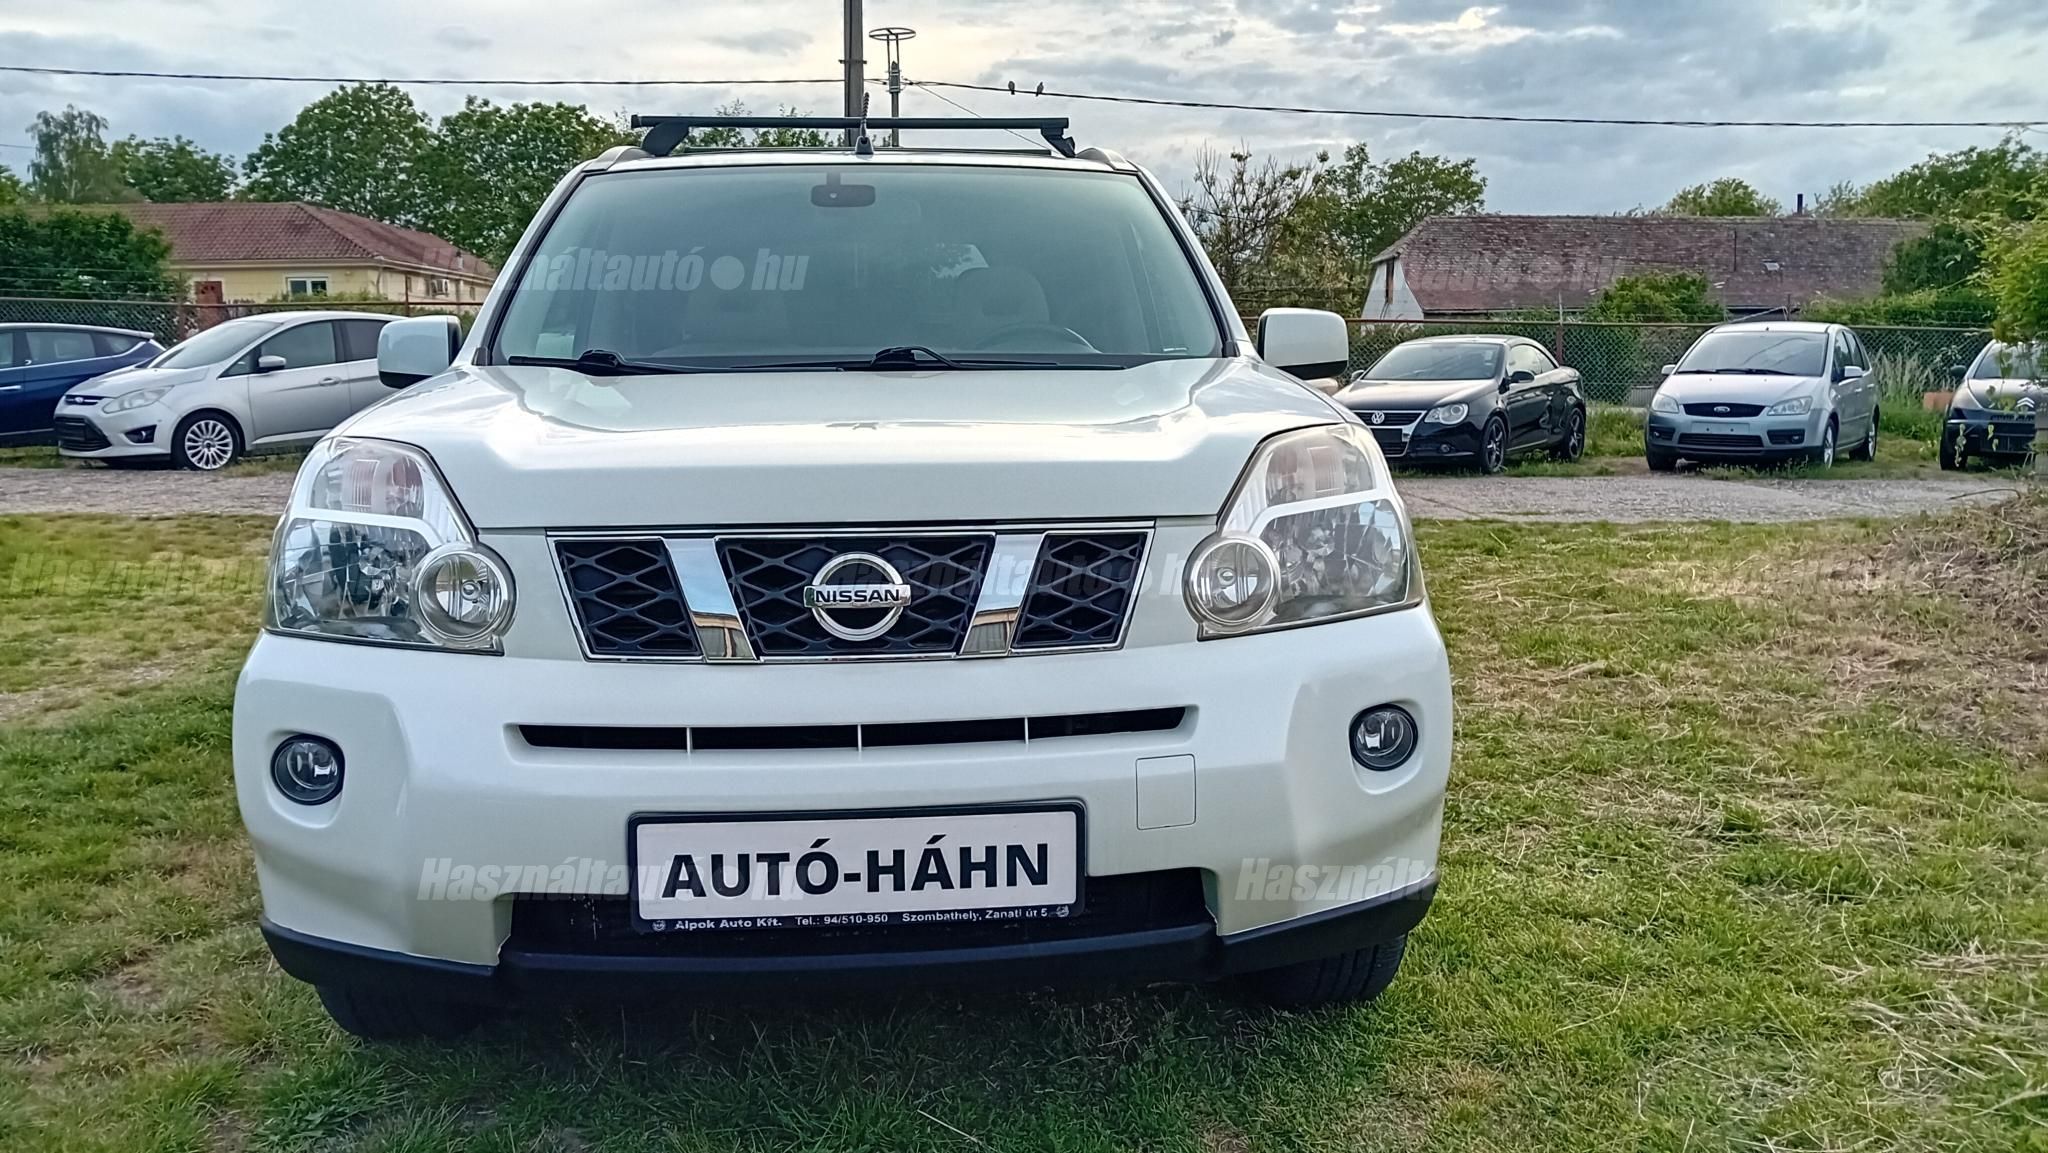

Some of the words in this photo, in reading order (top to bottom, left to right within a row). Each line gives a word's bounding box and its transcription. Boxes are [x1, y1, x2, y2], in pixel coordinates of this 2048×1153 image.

[815, 588, 900, 603] NISSAN
[661, 834, 1048, 899] AUTÓ-HÁHN
[675, 920, 715, 931] Alpok
[719, 918, 752, 929] Auto
[756, 917, 782, 928] Kft.
[823, 913, 888, 925] 94/510-950
